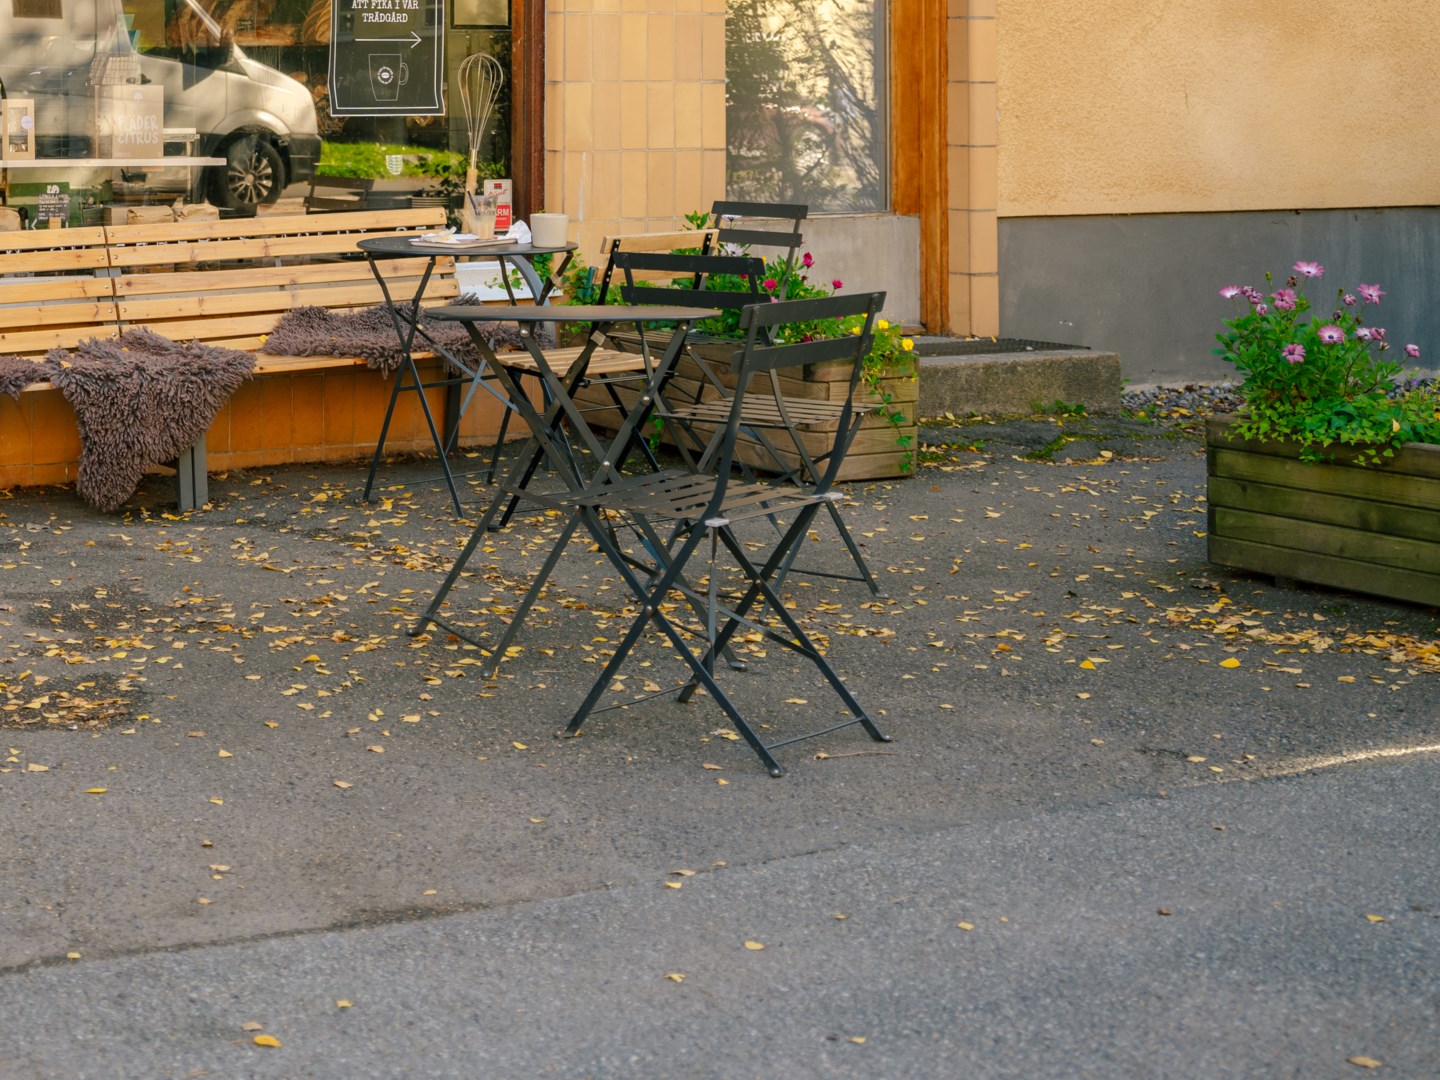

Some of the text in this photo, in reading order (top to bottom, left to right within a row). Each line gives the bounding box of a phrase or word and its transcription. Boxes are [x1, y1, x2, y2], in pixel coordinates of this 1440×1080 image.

[352, 0, 419, 9] ATT FIKA I VÅR
[362, 13, 409, 23] TRÄDGÅRD
